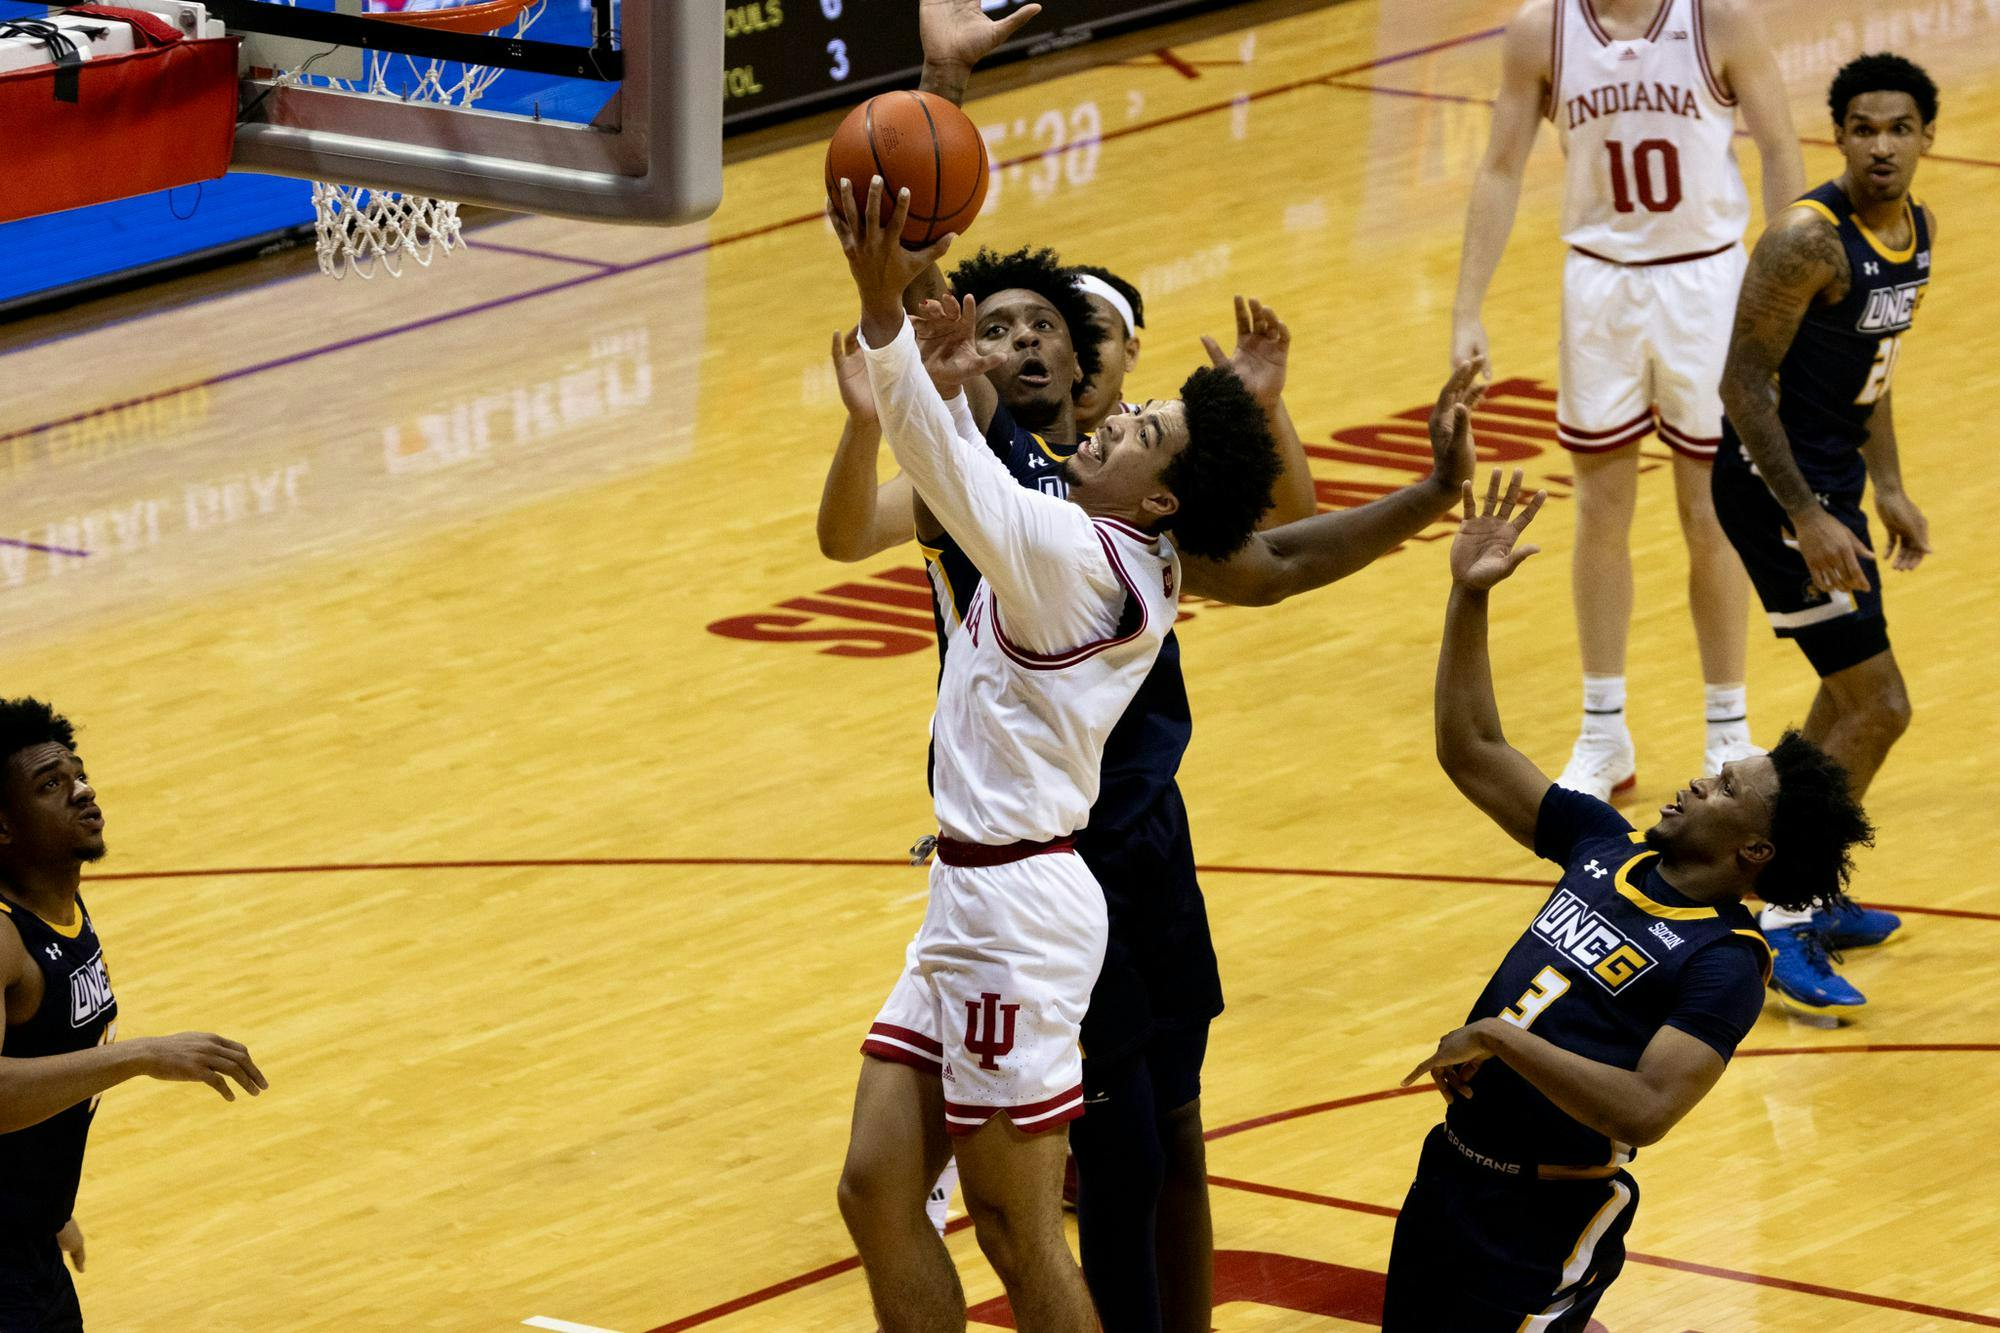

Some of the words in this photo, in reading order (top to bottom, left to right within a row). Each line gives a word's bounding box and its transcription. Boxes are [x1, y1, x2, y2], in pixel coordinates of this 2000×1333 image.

[725, 0, 783, 38] OULS
[826, 38, 850, 81] 3
[1567, 81, 1702, 130] INDIANA
[1604, 139, 1682, 213] 10
[1533, 891, 1653, 992] UNCG
[70, 948, 115, 1028] UNC
[1498, 965, 1571, 1031] 3
[1447, 1129, 1521, 1175] SPARTANS
